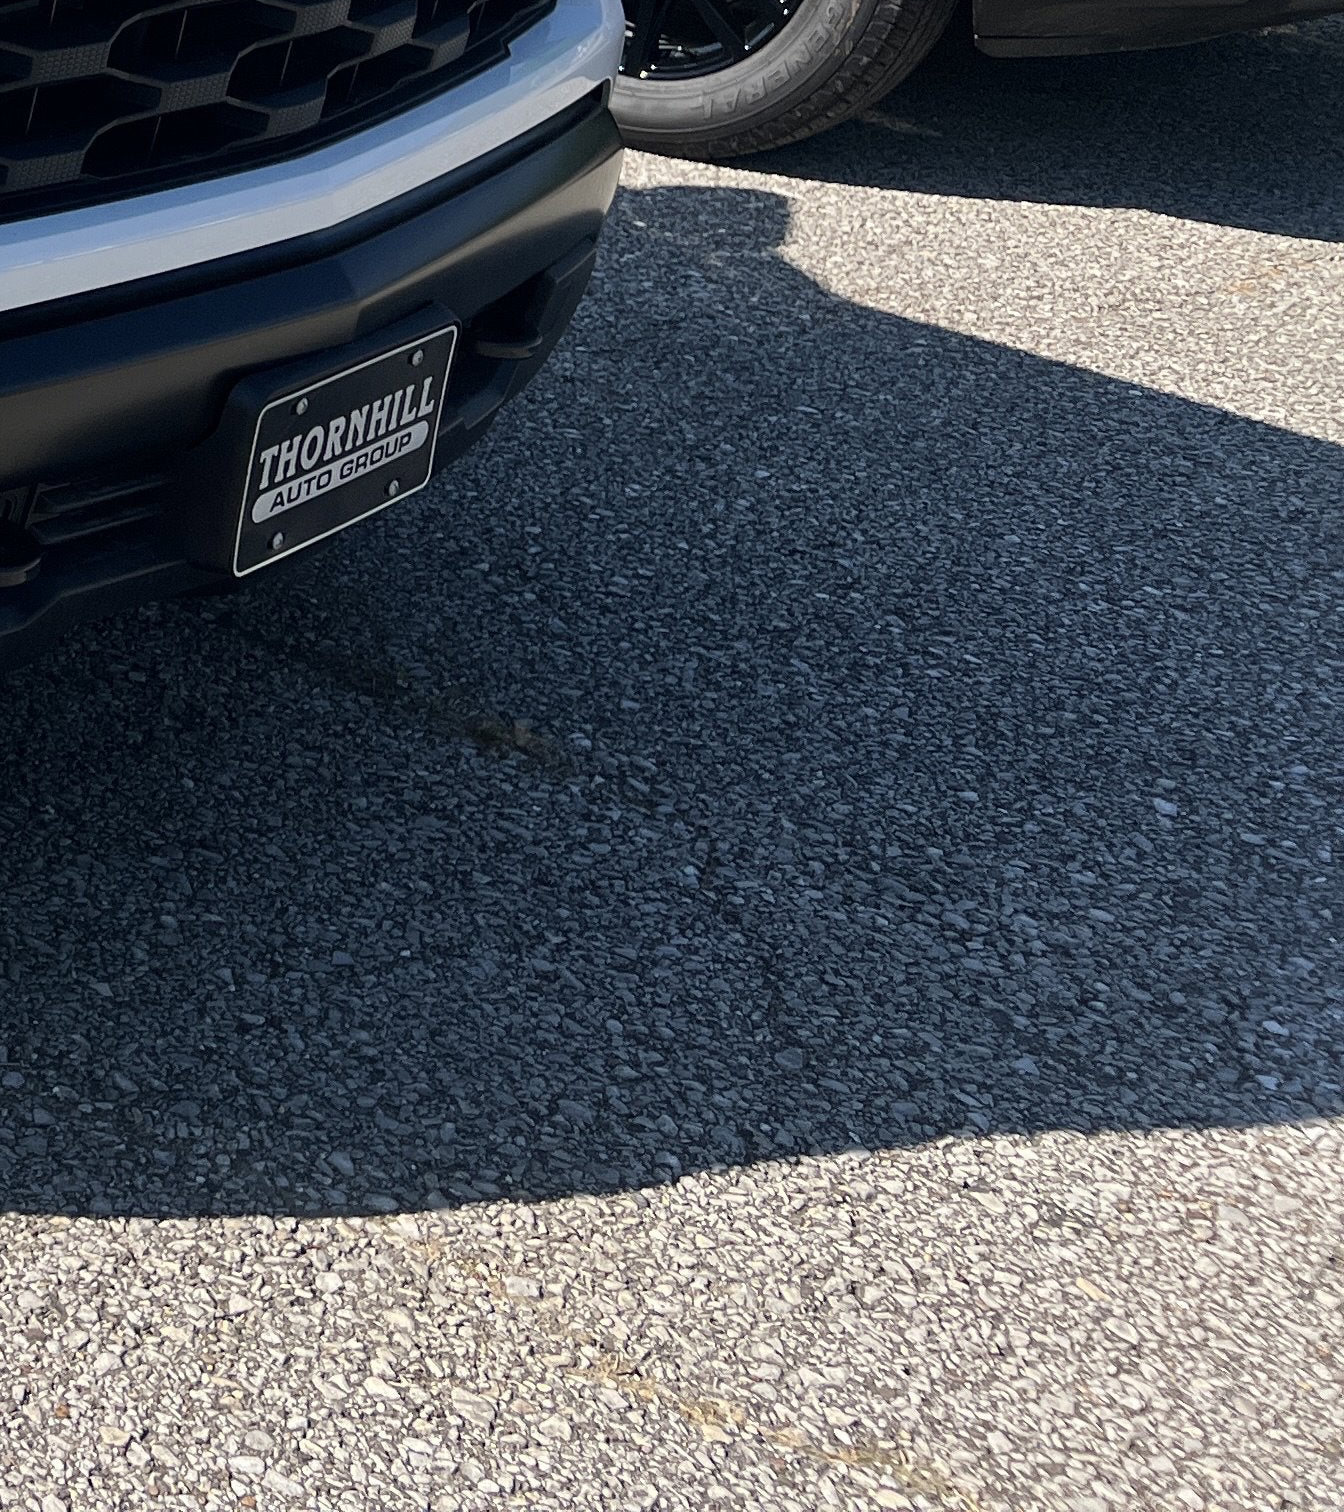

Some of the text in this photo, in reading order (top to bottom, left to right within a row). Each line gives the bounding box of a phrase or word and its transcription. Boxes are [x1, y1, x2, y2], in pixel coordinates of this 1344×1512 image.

[259, 376, 435, 491] THORNHILL
[269, 431, 413, 512] AUTO GROUP
